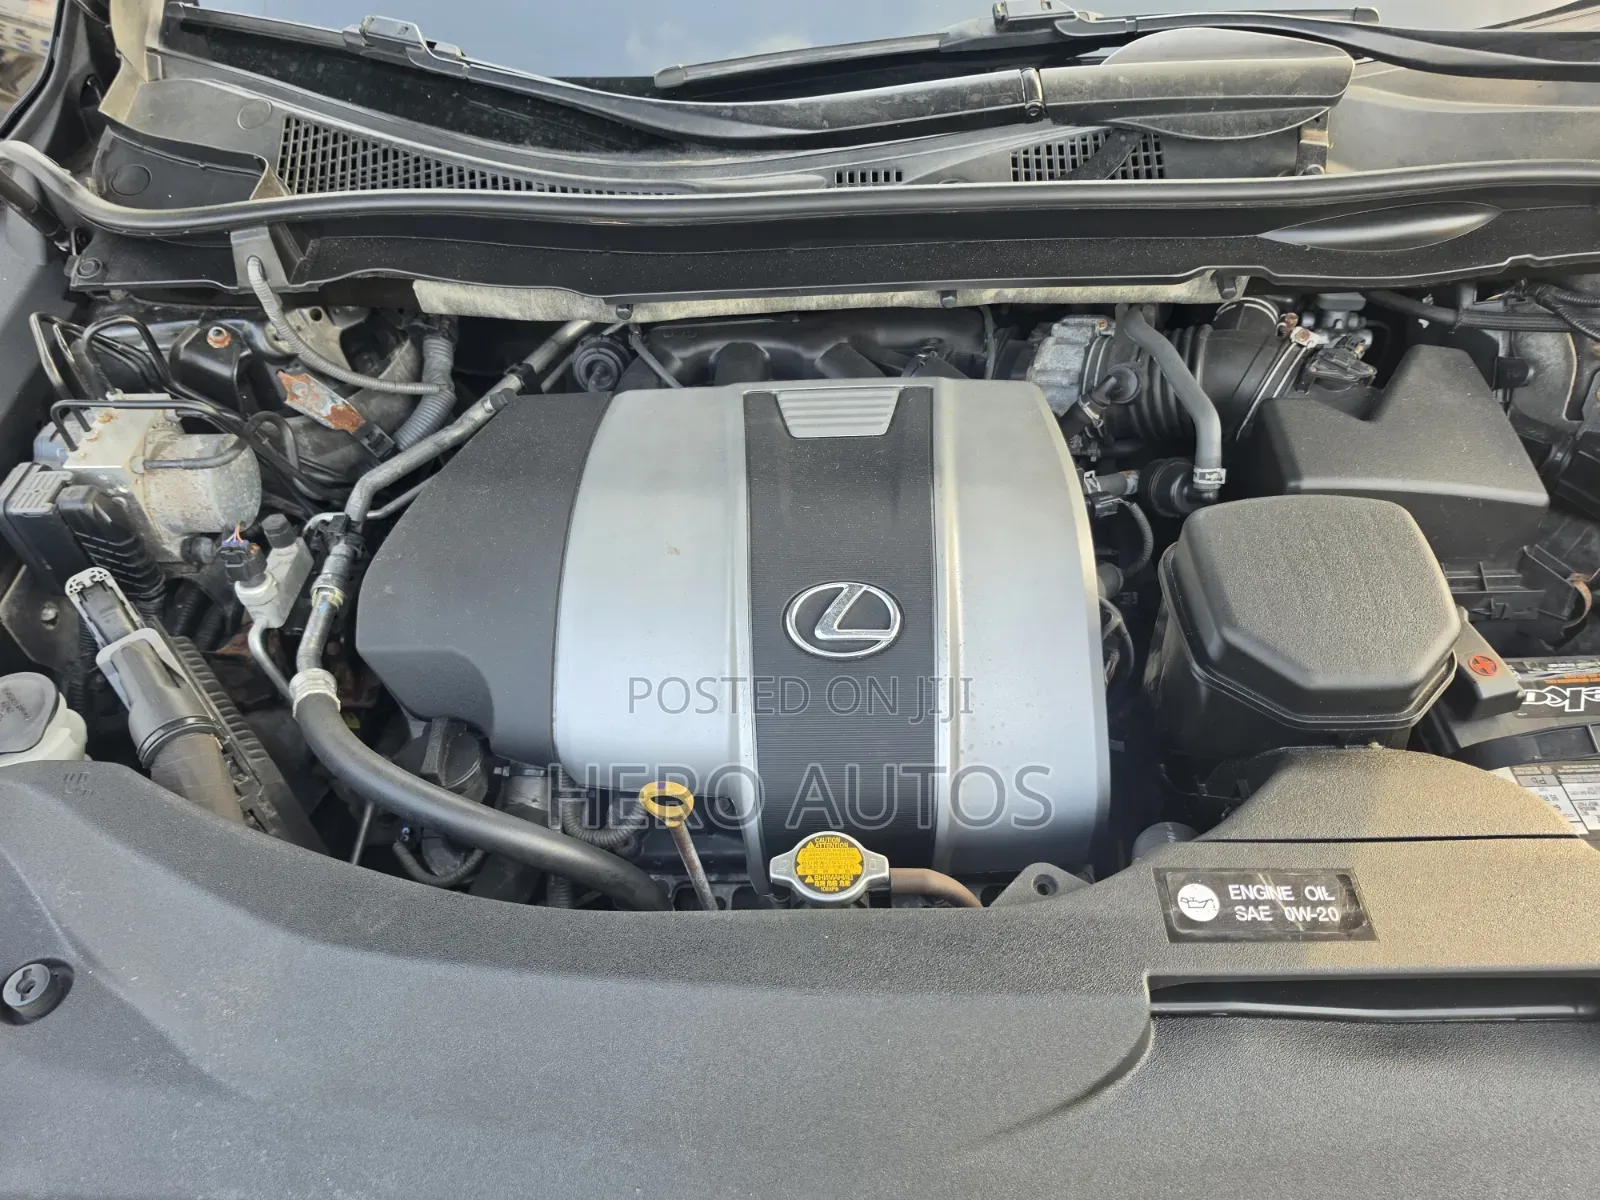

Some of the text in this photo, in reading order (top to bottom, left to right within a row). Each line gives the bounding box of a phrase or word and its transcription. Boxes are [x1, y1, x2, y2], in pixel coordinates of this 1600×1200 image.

[1228, 884, 1335, 901] ENGINE OIL
[1235, 906, 1340, 922] SAE 0W-20
